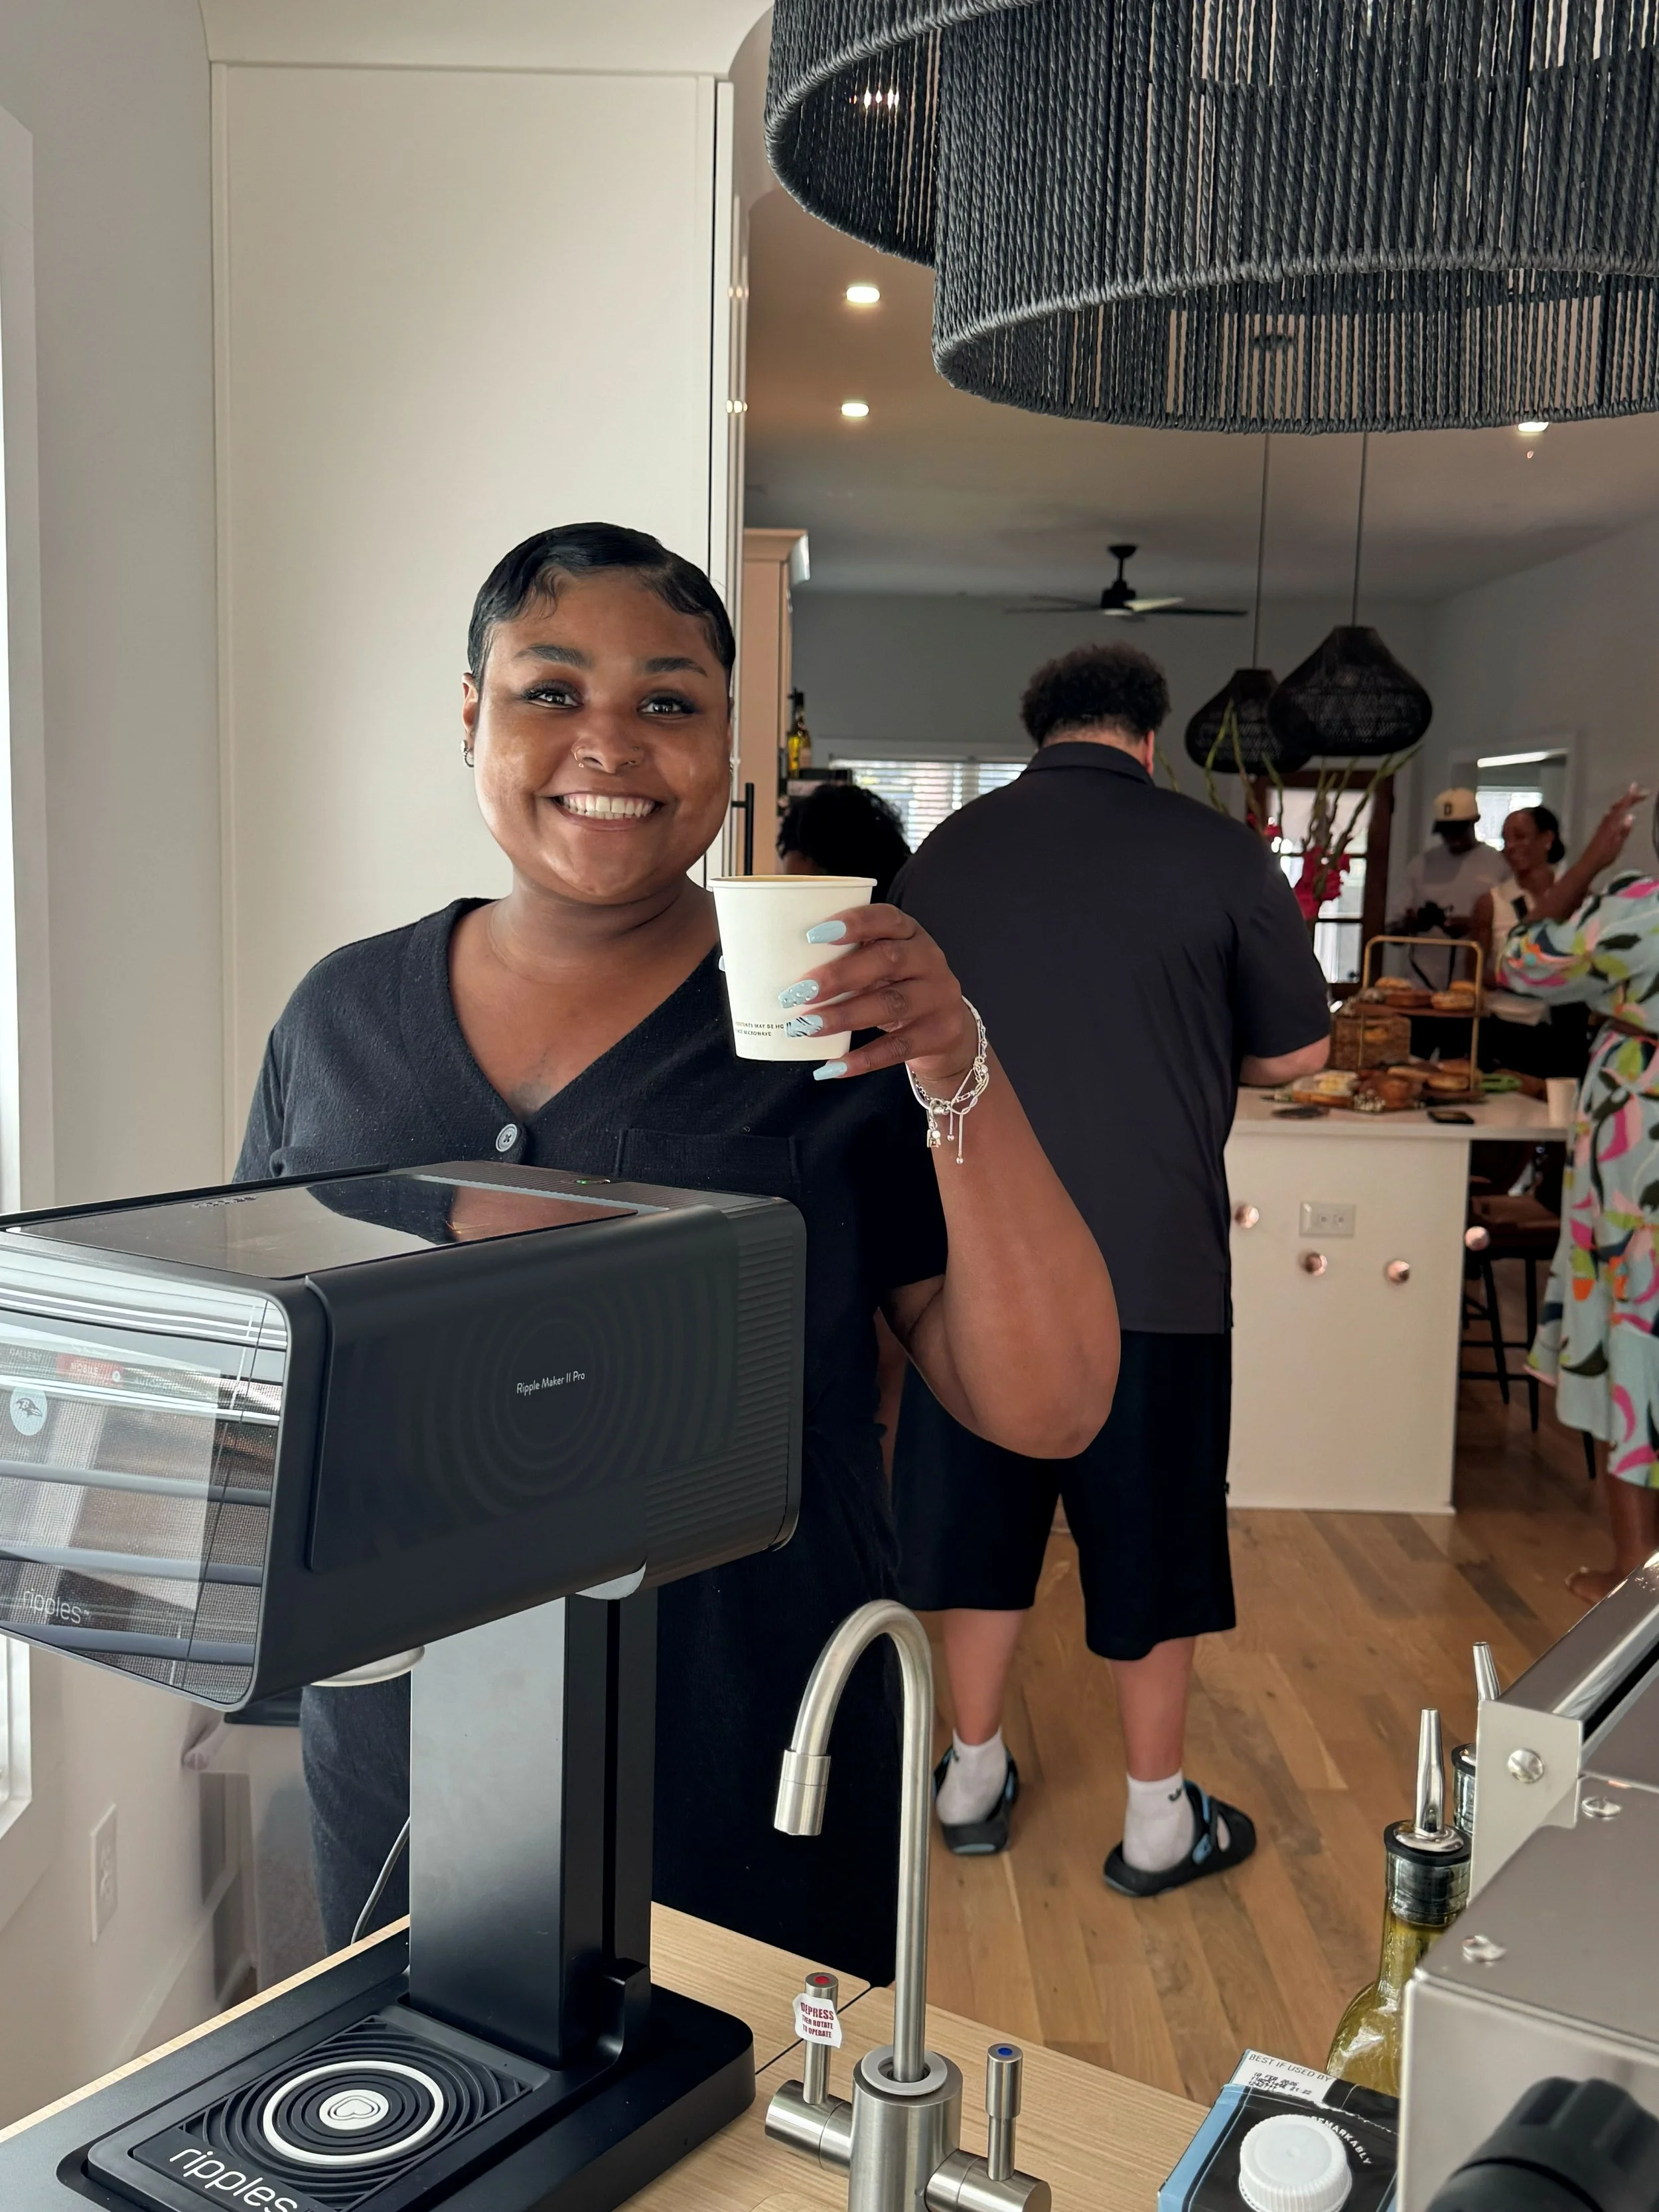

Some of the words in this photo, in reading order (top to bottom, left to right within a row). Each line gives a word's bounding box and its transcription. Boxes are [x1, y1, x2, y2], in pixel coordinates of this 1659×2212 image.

[70, 1363, 98, 1376] MOBILE
[517, 1380, 540, 1396] Ripple
[541, 1376, 565, 1388] Maker
[566, 1372, 571, 1383] II
[573, 1370, 585, 1382] Pro
[23, 1588, 82, 1623] ripples
[800, 2002, 834, 2021] DEPRESS
[808, 2027, 832, 2039] OPERATE
[812, 2020, 833, 2030] ROTATE
[1249, 2054, 1274, 2065] BEST
[1287, 2065, 1315, 2077] USED
[169, 2148, 298, 2212] ripples
